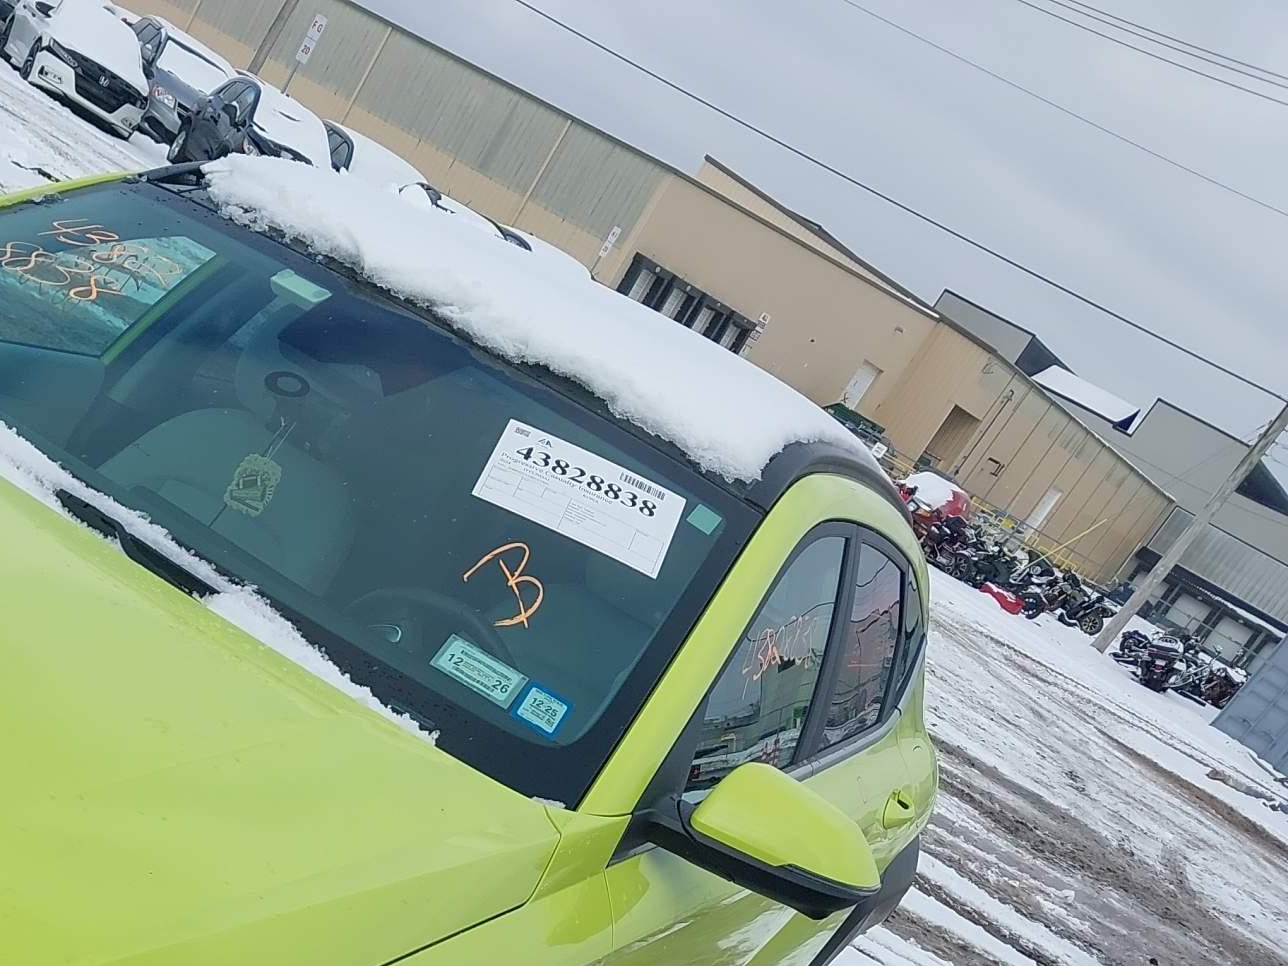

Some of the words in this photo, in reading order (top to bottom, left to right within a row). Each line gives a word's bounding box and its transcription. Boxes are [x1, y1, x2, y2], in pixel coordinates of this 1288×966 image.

[516, 446, 657, 517] 43828838
[463, 542, 543, 628] B
[447, 653, 463, 666] 12
[492, 680, 509, 693] 26
[545, 705, 559, 717] 25
